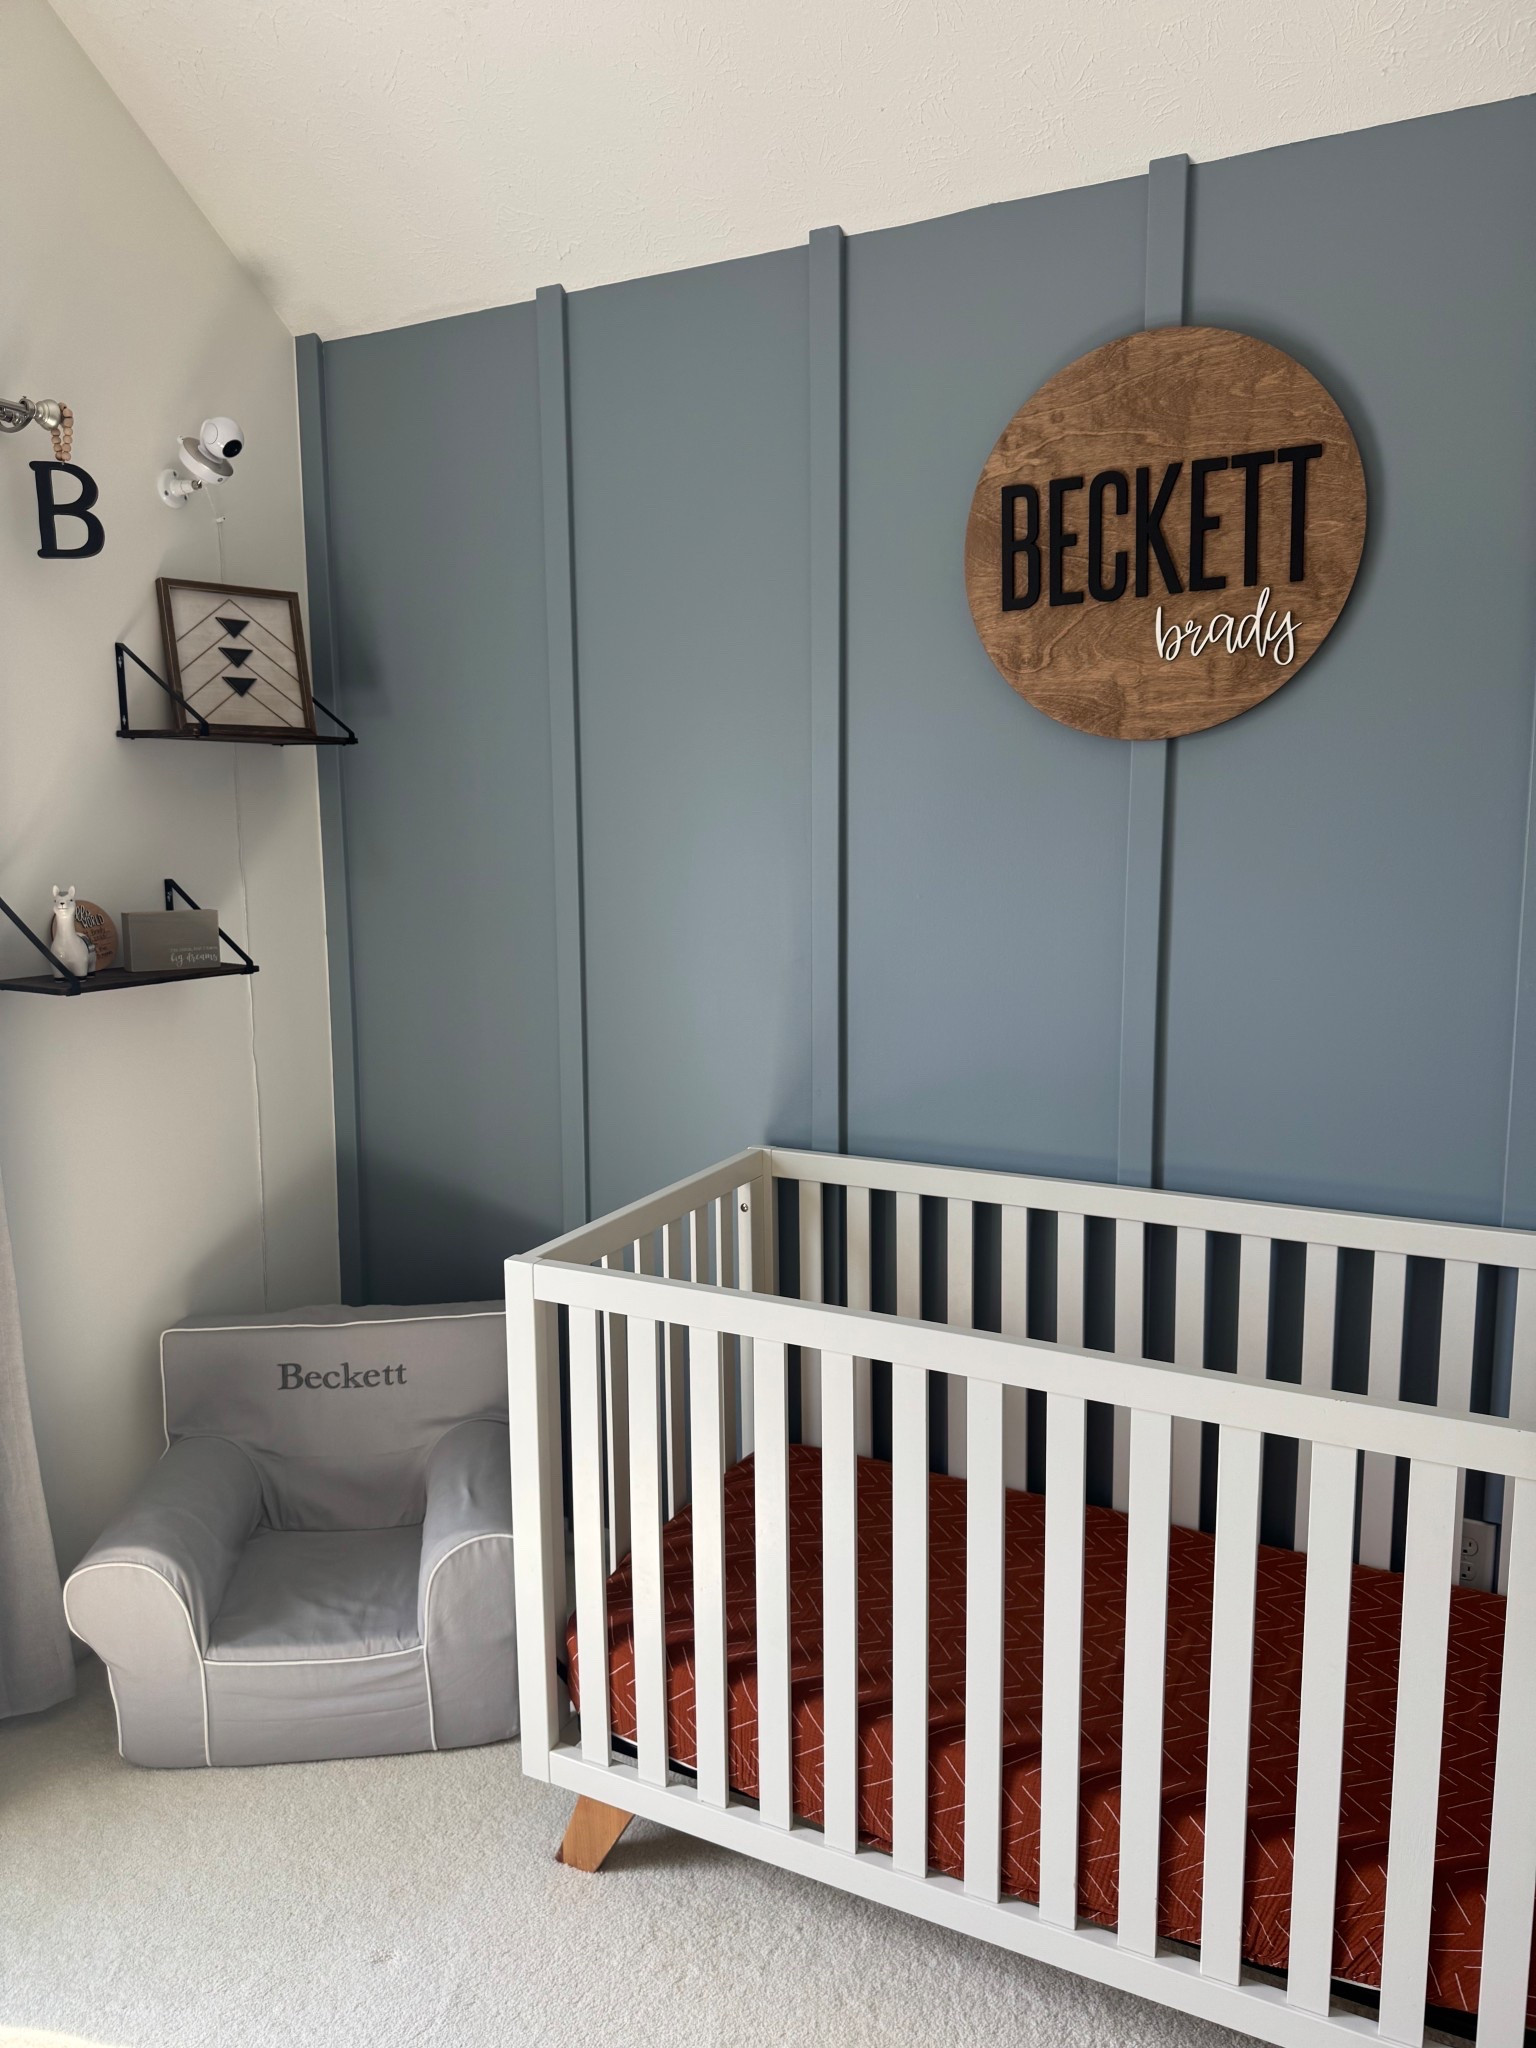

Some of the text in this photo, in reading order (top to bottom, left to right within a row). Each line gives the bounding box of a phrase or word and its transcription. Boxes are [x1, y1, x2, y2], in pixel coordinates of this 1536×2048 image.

[29, 460, 106, 559] B
[1001, 443, 1323, 611] BECKETT
[1155, 586, 1303, 666] brady
[277, 1361, 408, 1391] Beckett
